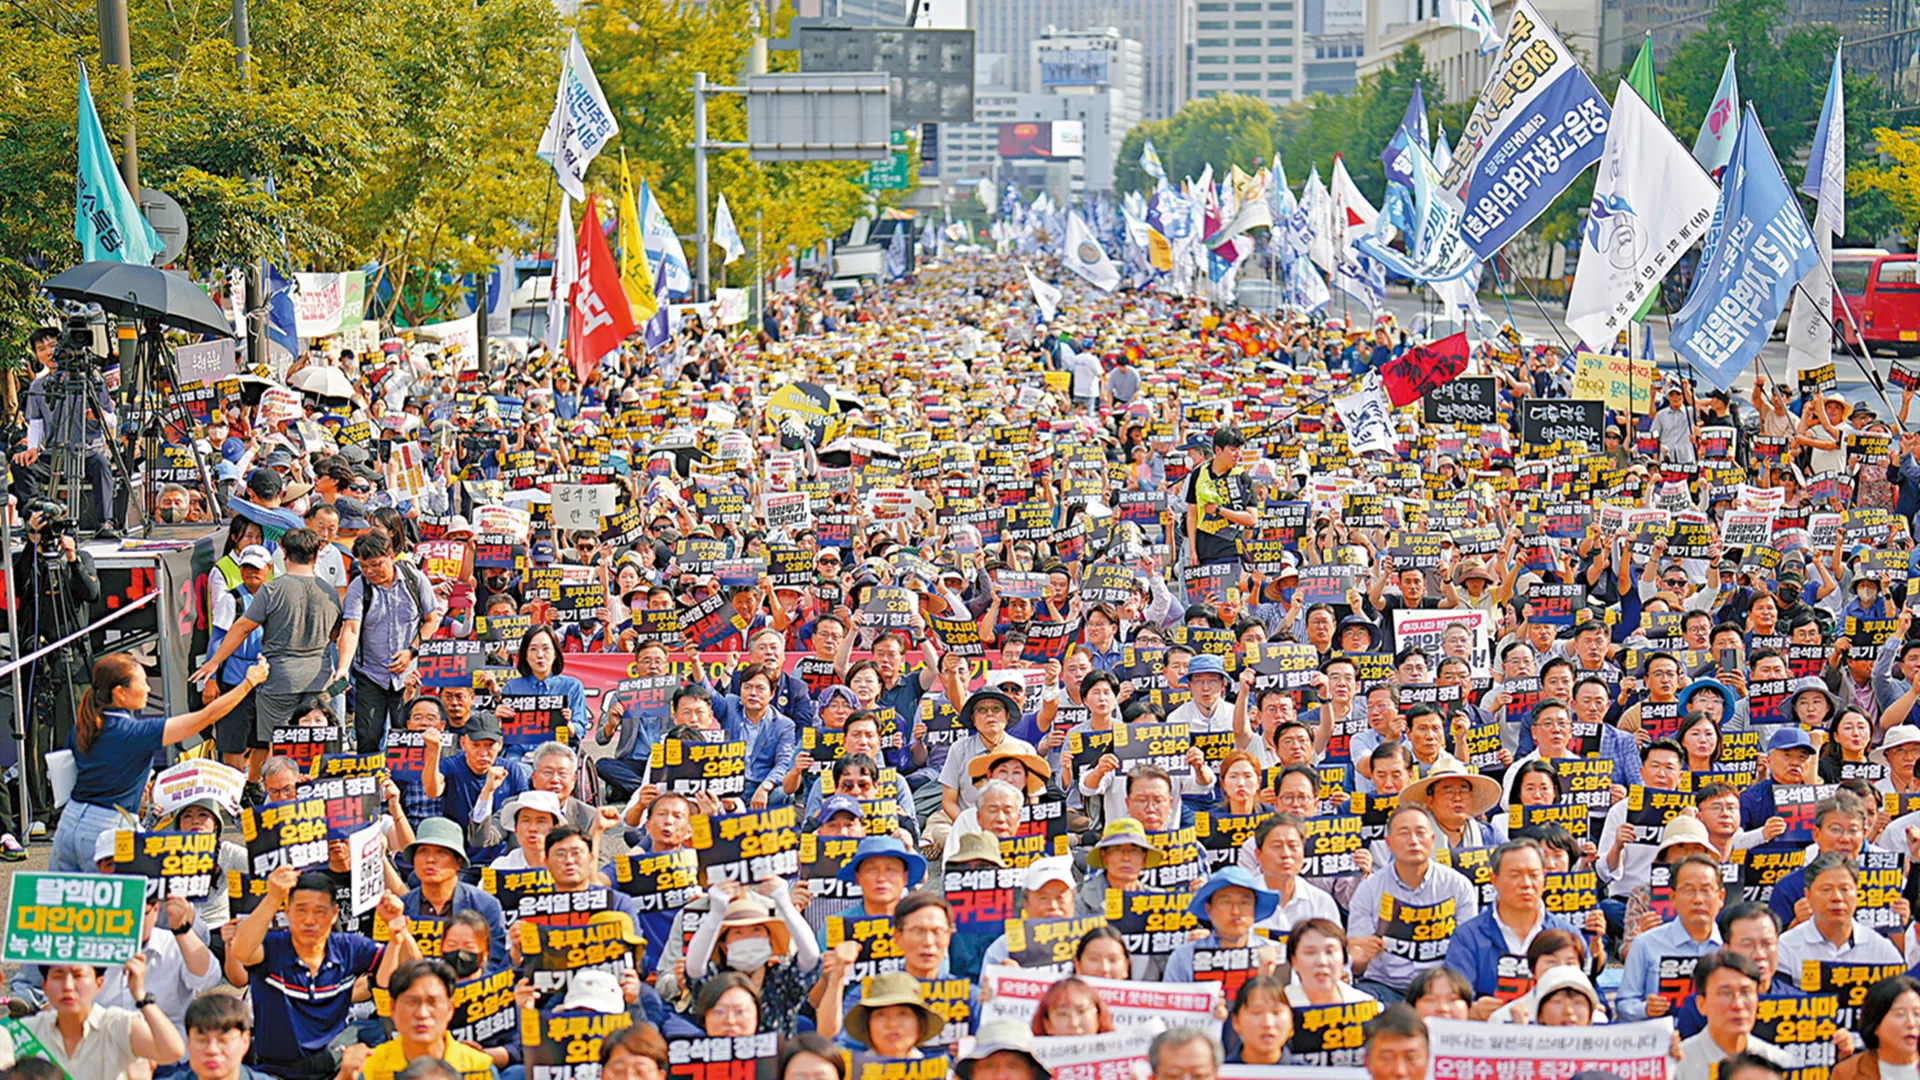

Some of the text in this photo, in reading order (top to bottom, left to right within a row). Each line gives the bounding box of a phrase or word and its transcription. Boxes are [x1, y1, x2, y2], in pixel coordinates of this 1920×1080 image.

[1120, 502, 1155, 518] 규탄!
[817, 526, 851, 542] 규탄!
[1546, 515, 1581, 531] 규탄!
[416, 543, 465, 560] 윤석열
[476, 545, 512, 560] 규탄!
[1186, 578, 1221, 597] 규탄!
[1300, 578, 1341, 596] 규탄!
[1530, 585, 1582, 598] 윤석열 정권
[1530, 598, 1571, 616] 규탄!
[419, 639, 480, 655] 윤석열 정권
[1267, 644, 1318, 662] 후쿠시마
[418, 656, 466, 682] 규탄!
[803, 661, 834, 675] 윤석열
[1280, 656, 1319, 672] 오염수
[618, 675, 677, 692] 윤석열 정권
[1401, 684, 1460, 703] 윤석열 정권
[1504, 679, 1540, 693] 윤석열
[502, 695, 563, 710] 윤석열 정권
[619, 688, 665, 711] 규탄!
[1640, 703, 1678, 719] 윤석열
[502, 710, 550, 736] 규탄!
[1135, 723, 1190, 743] 후쿠시마
[272, 725, 339, 744] 윤석열 정권
[690, 744, 746, 763] 후쿠시마
[1149, 740, 1190, 757] 오염수
[326, 752, 387, 775] 후쿠시마
[703, 761, 745, 779] 오염수
[1559, 757, 1613, 776] 후쿠시마
[1842, 764, 1880, 780] 윤석열
[296, 776, 376, 799] 윤석열 정권
[674, 777, 746, 798] 투기 철회!
[1571, 775, 1613, 792] 오염수
[1774, 787, 1815, 803] 윤석열
[260, 801, 327, 831] 후쿠시마
[1032, 801, 1062, 822] 정권
[1530, 805, 1588, 824] 후쿠시마
[279, 821, 329, 846] 오염수
[719, 806, 798, 841] 후쿠시마
[144, 833, 217, 857] 후쿠시마
[740, 829, 798, 858] 오염수
[1316, 834, 1362, 855] 오염수
[1635, 826, 1664, 845] 투기
[161, 854, 215, 877] 오염수
[254, 840, 330, 878] 투기 철회!
[639, 851, 699, 877] 후쿠시마
[706, 851, 799, 886] 투기 철회!
[1867, 851, 1898, 869] 정권
[168, 874, 211, 898] 철회!
[656, 869, 698, 891] 오염수
[944, 868, 996, 892] 윤석열
[35, 877, 123, 910] 탈핵이
[518, 889, 608, 916] 윤석열 정권
[1546, 889, 1598, 911] 오염수
[945, 890, 1013, 925] 규탄!
[1397, 897, 1456, 925] 후쿠시마
[16, 905, 135, 936] 대안이다
[1032, 914, 1108, 947] 후쿠시마
[1145, 908, 1199, 932] 오염수
[1411, 917, 1456, 943] 오염수
[547, 920, 623, 951] 후쿠시마
[8, 933, 136, 963] 녹색당 김유리
[566, 943, 625, 968] 오염수
[1193, 949, 1248, 972] 윤석열
[533, 968, 572, 994] 투기
[466, 990, 515, 1025] 오염수
[1301, 1000, 1381, 1033] 후쿠시마
[1757, 995, 1839, 1024] 후쿠시마
[547, 1011, 633, 1042] 후쿠시마
[1775, 1019, 1837, 1043] 오염수
[668, 1031, 779, 1064] 윤석열 정권
[860, 1054, 949, 1080] 후쿠시마
[1436, 1059, 1493, 1080] 오염수
